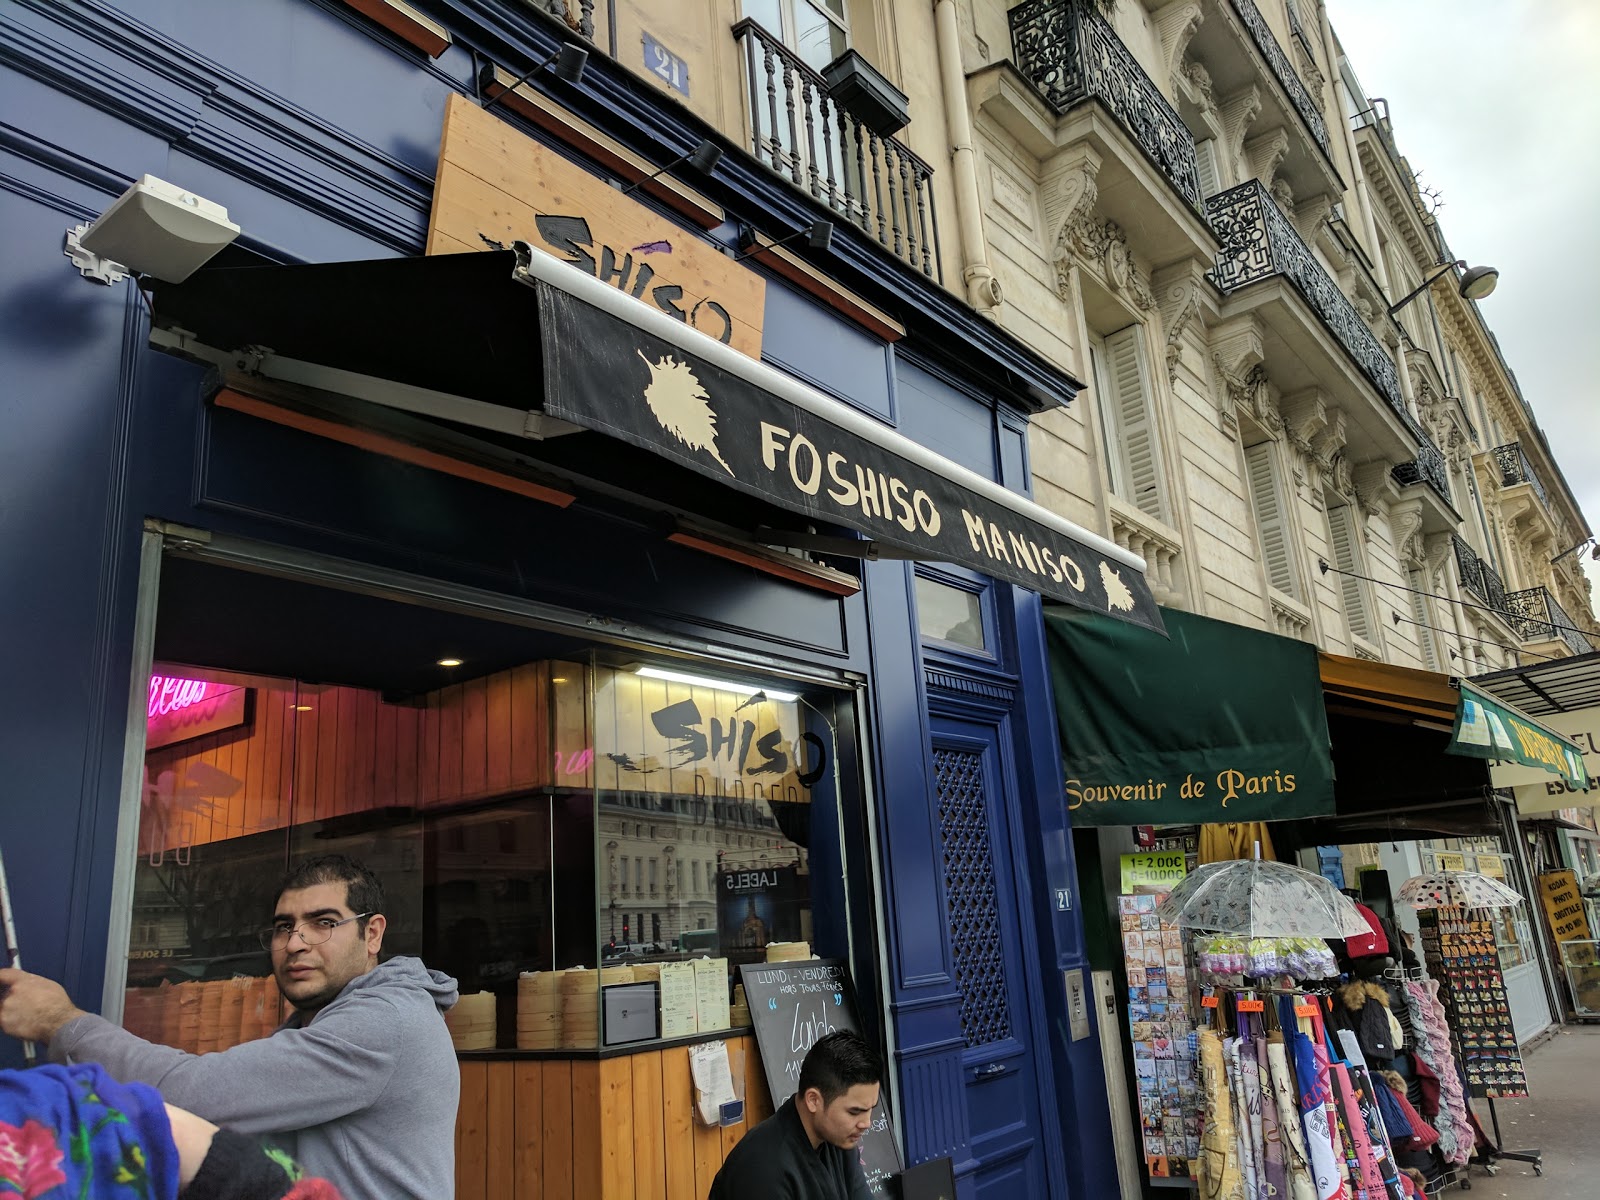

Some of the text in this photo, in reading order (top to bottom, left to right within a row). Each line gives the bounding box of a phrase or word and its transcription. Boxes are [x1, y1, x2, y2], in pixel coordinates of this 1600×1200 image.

[654, 46, 680, 88] 21
[760, 421, 1085, 592] FOSHISO MANISO
[1065, 768, 1296, 811] Souvenir de Paris
[1058, 891, 1069, 909] 21
[1553, 891, 1573, 905] PHOTO
[1553, 903, 1581, 920] DIGITALE
[799, 966, 845, 981] VENDREDI
